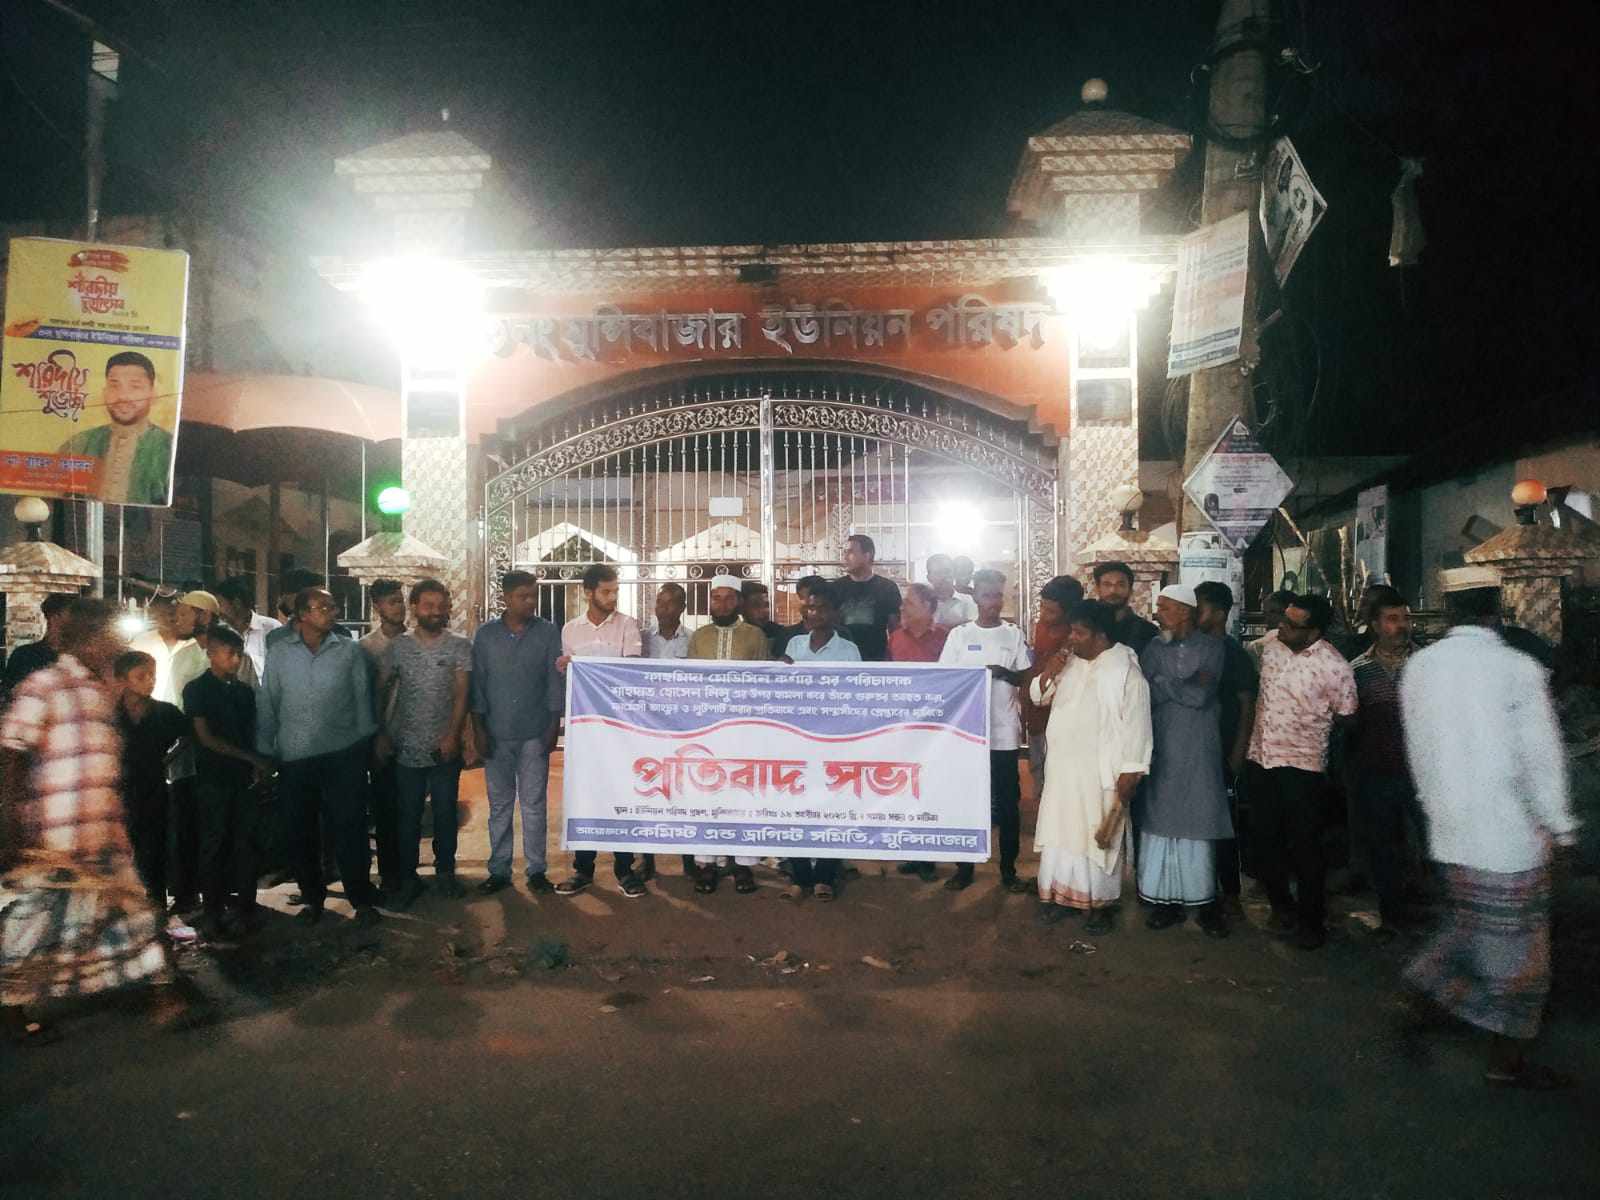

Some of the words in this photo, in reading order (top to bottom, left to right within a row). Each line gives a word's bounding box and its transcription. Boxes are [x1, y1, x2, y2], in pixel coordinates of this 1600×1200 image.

[759, 298, 912, 354] ইউনিয়ন
[927, 293, 1060, 350] পরিষদ
[708, 671, 770, 684] মেডিসিন
[818, 675, 840, 686] এর
[846, 673, 912, 687] পরিচালক
[660, 686, 701, 699] হোসেন
[632, 744, 808, 800] প্রতিবাদ
[824, 760, 922, 801] সভা
[880, 830, 978, 849] মুন্সিবাজার
